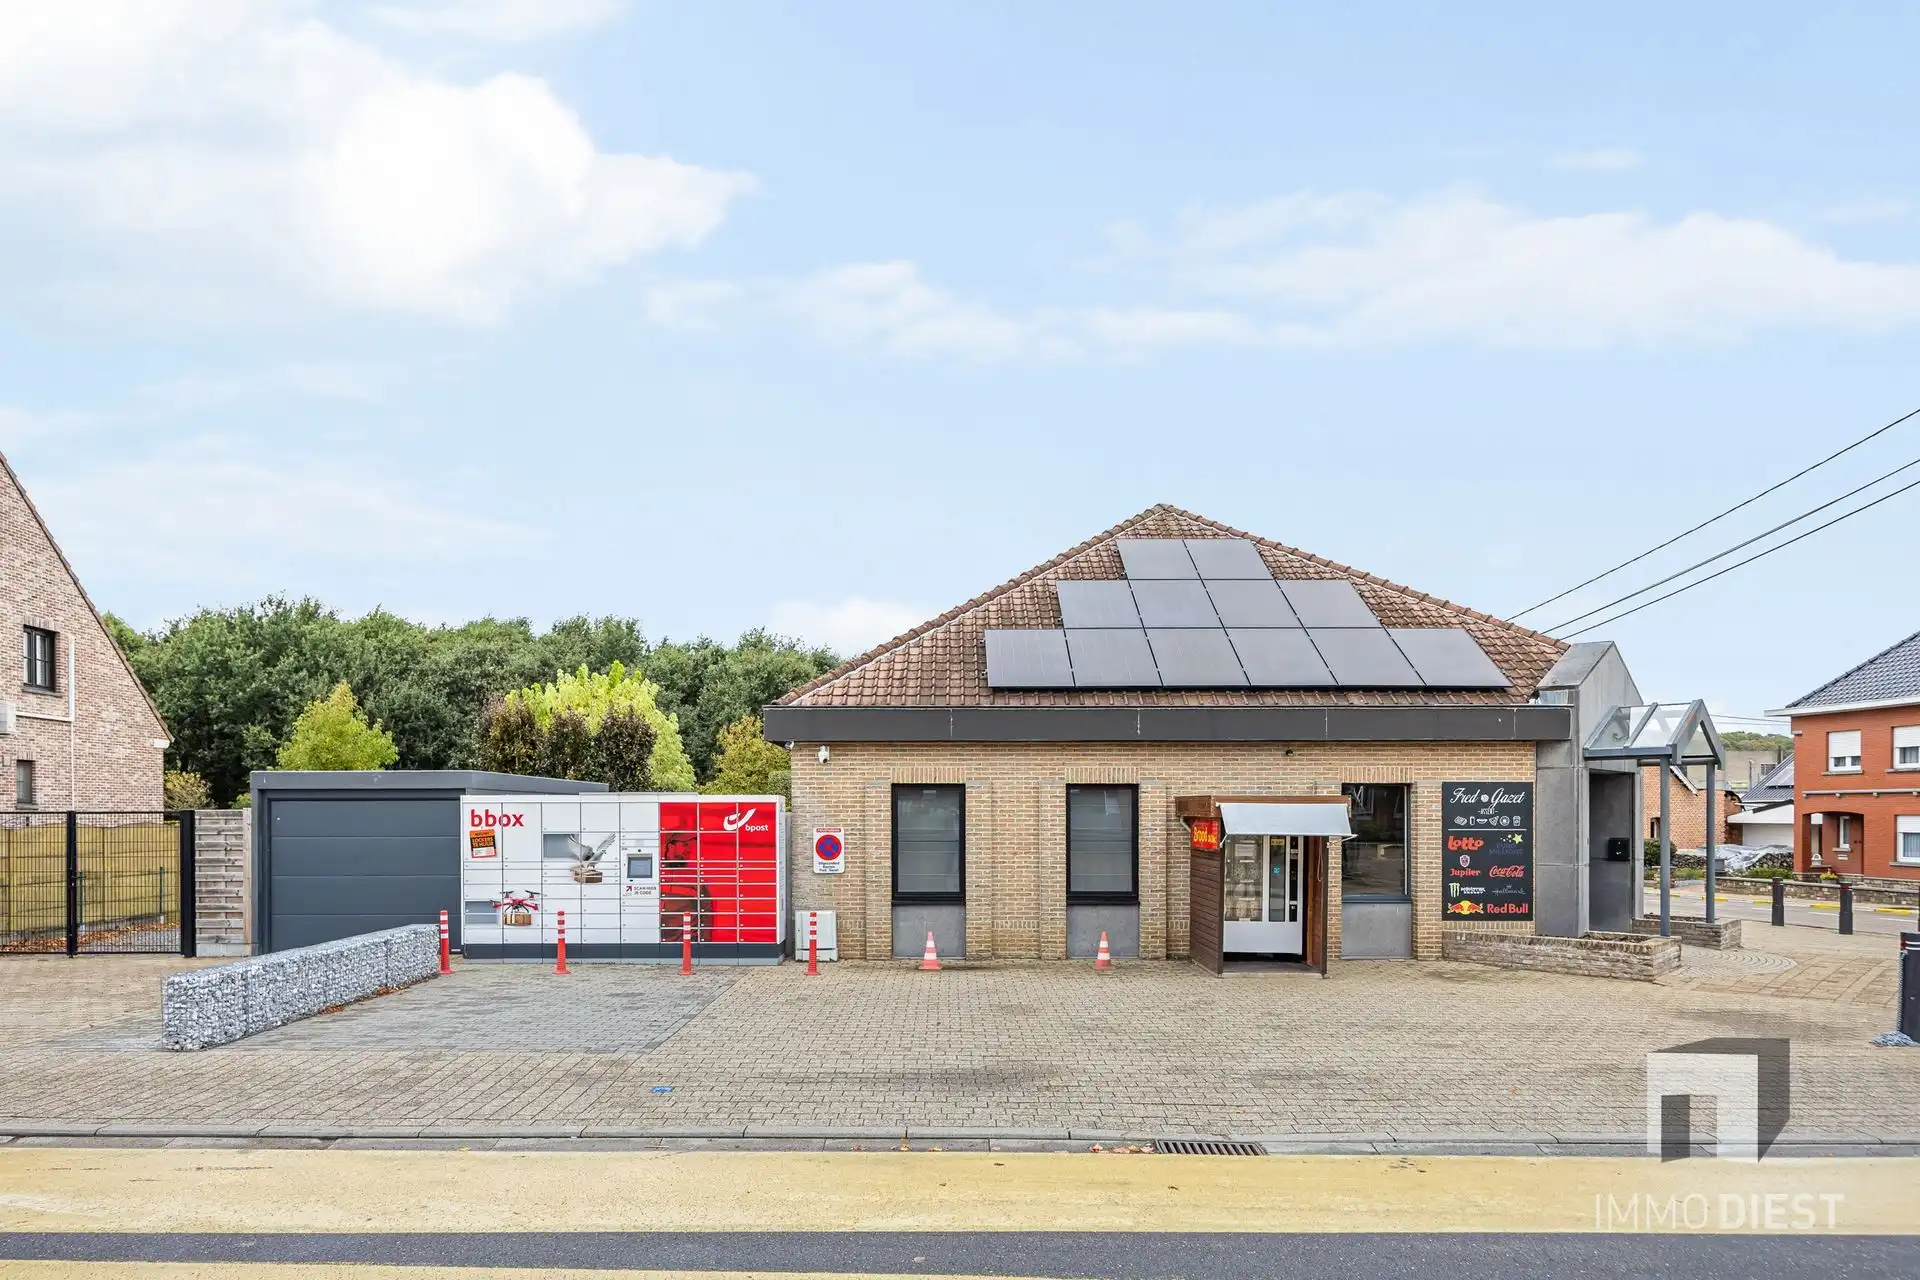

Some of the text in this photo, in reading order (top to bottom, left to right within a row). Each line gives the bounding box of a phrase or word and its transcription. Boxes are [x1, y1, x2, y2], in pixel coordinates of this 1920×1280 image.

[1450, 788, 1525, 809] Fred Gazet
[471, 809, 524, 827] bbox
[745, 824, 768, 832] bpost
[1449, 869, 1480, 877] Jupiler
[1487, 904, 1528, 913] Red Bull
